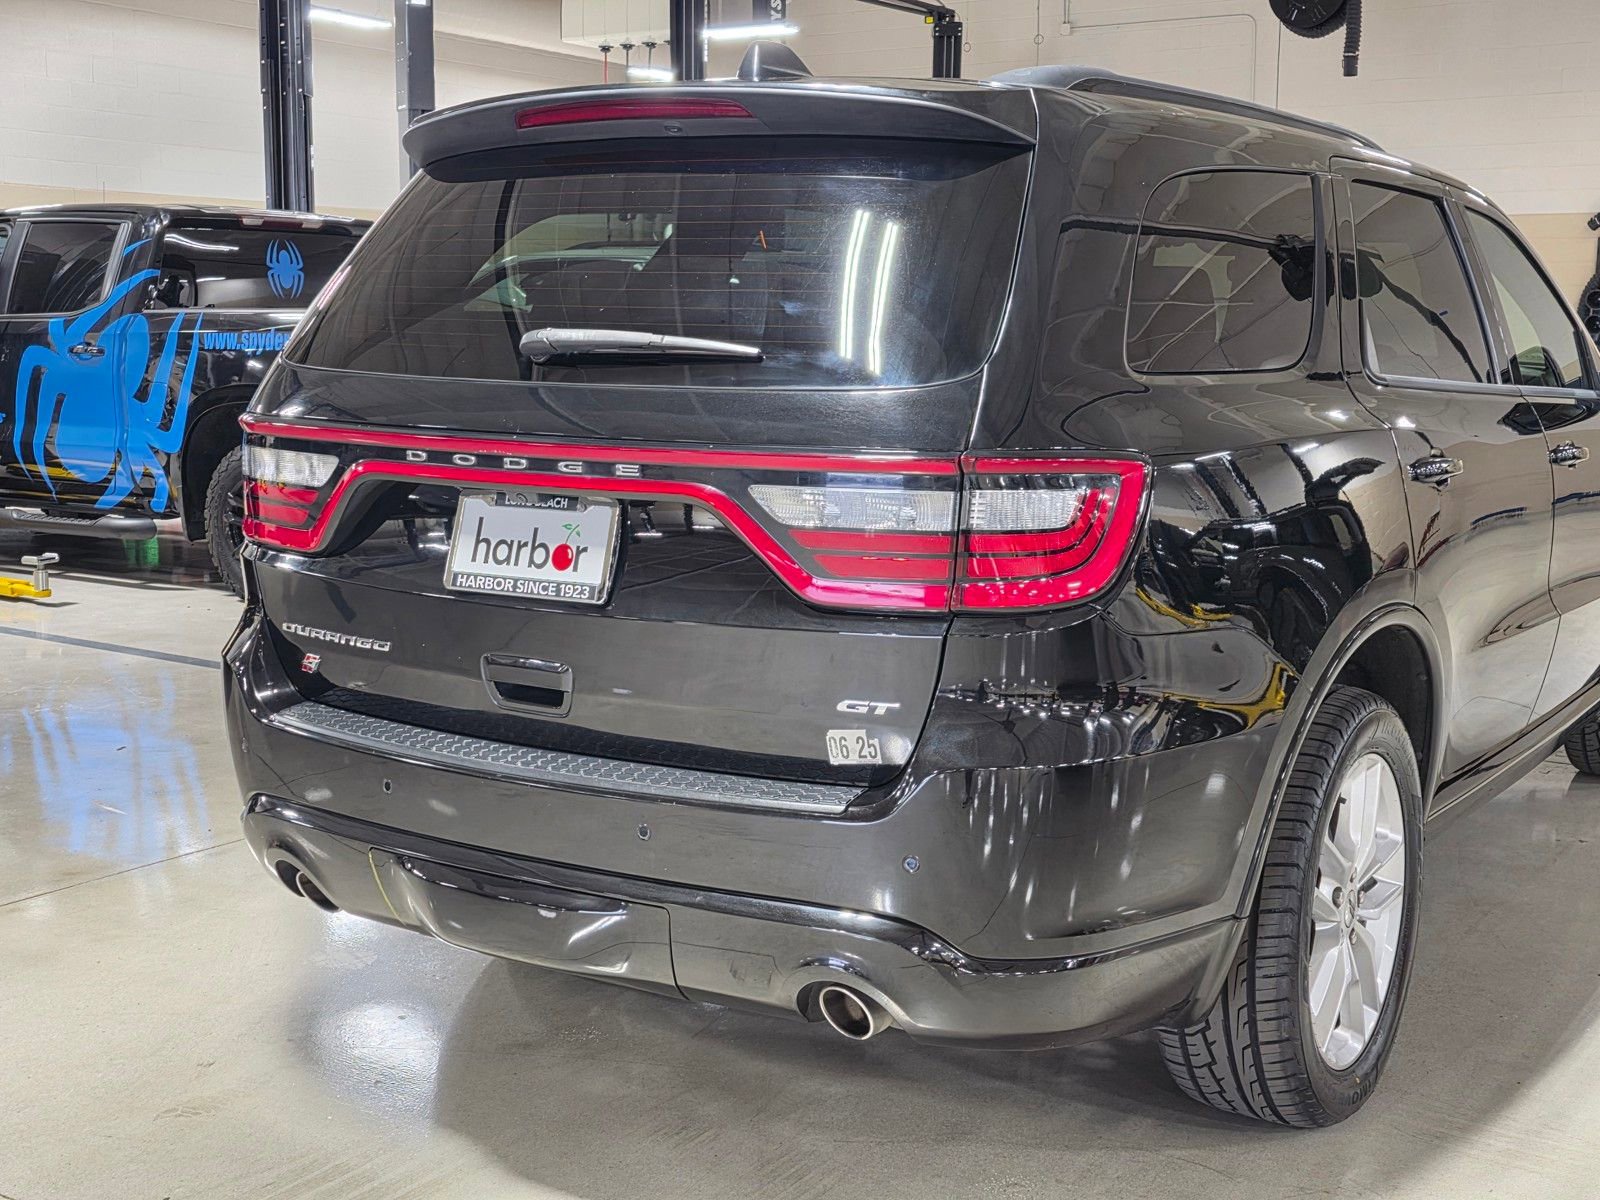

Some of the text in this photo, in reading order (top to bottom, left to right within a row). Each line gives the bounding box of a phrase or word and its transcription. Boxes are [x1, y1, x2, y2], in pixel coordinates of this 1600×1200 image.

[406, 450, 641, 476] DODGE
[471, 516, 589, 573] harbor
[456, 574, 590, 599] HARBOR SINCE 1923
[282, 622, 392, 652] DURANGO
[836, 700, 901, 715] GT
[856, 736, 878, 759] 25
